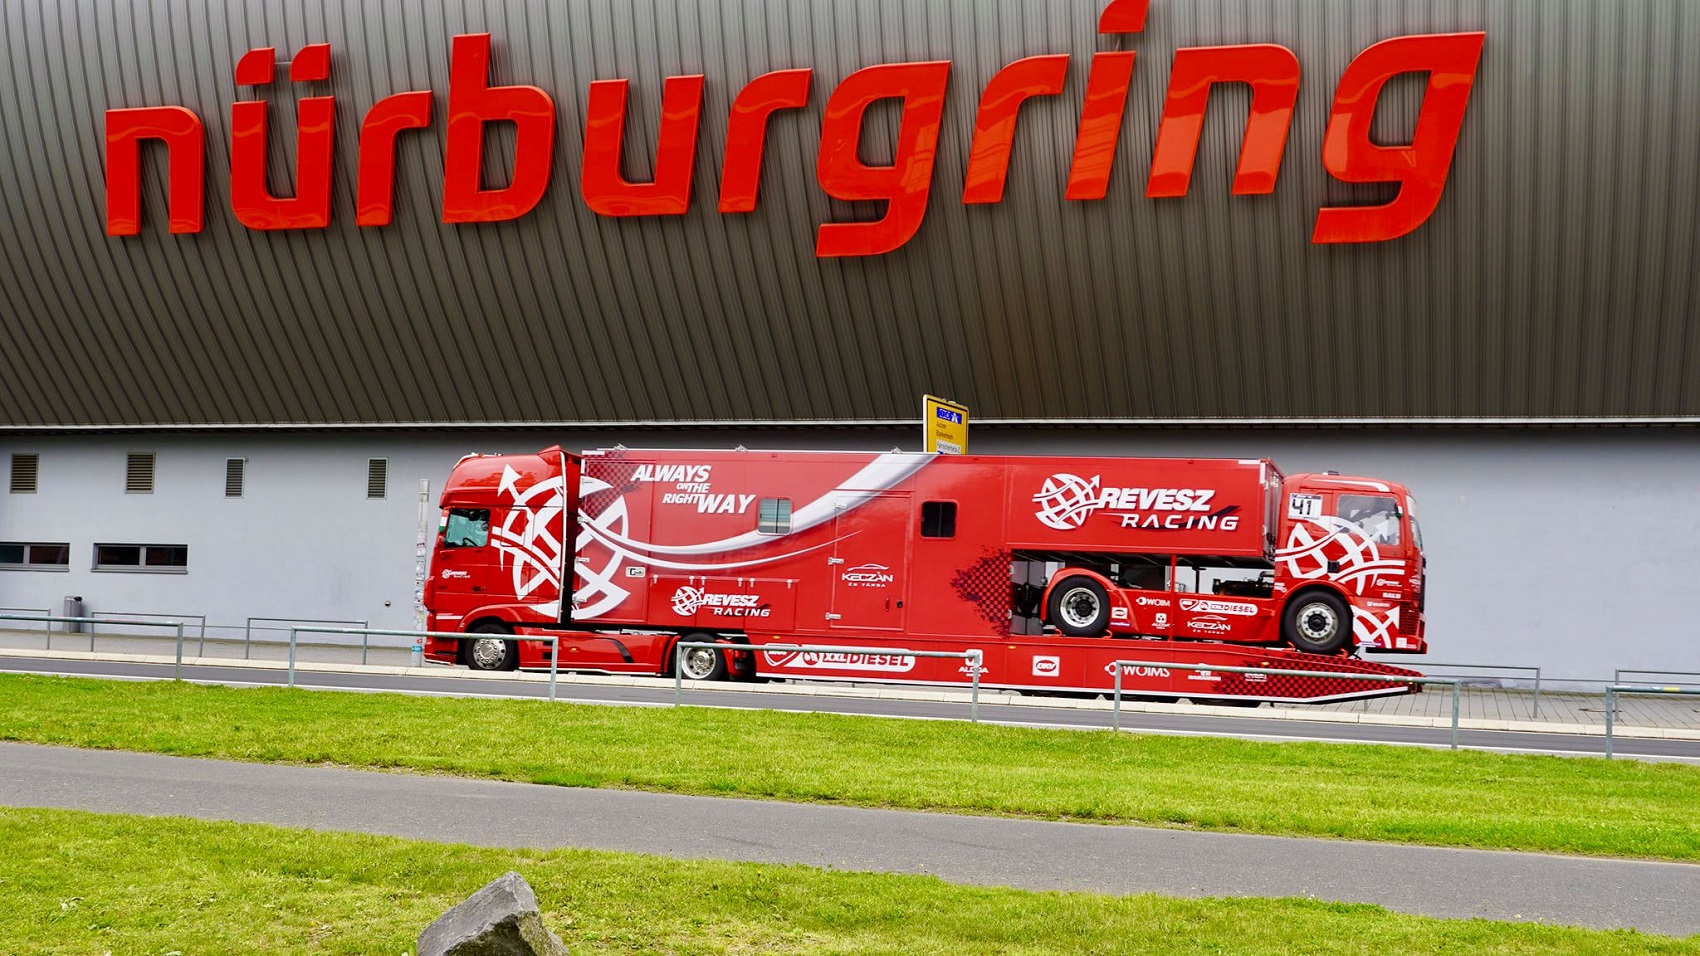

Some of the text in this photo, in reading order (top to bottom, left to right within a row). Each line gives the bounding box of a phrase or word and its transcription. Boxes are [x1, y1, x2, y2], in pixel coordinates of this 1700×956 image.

[105, 0, 1486, 258] nürburgring
[630, 464, 712, 482] ALWAYS
[687, 483, 711, 493] THE
[662, 493, 756, 514] RIGHT WAY
[1098, 487, 1215, 511] REVESZ
[1292, 498, 1312, 516] 41
[1121, 513, 1240, 530] RACING
[702, 593, 760, 607] REVESZ
[1146, 598, 1171, 607] WOIM
[713, 607, 771, 617] RACING
[1223, 603, 1254, 613] DIESEL
[849, 653, 909, 667] DIESEL
